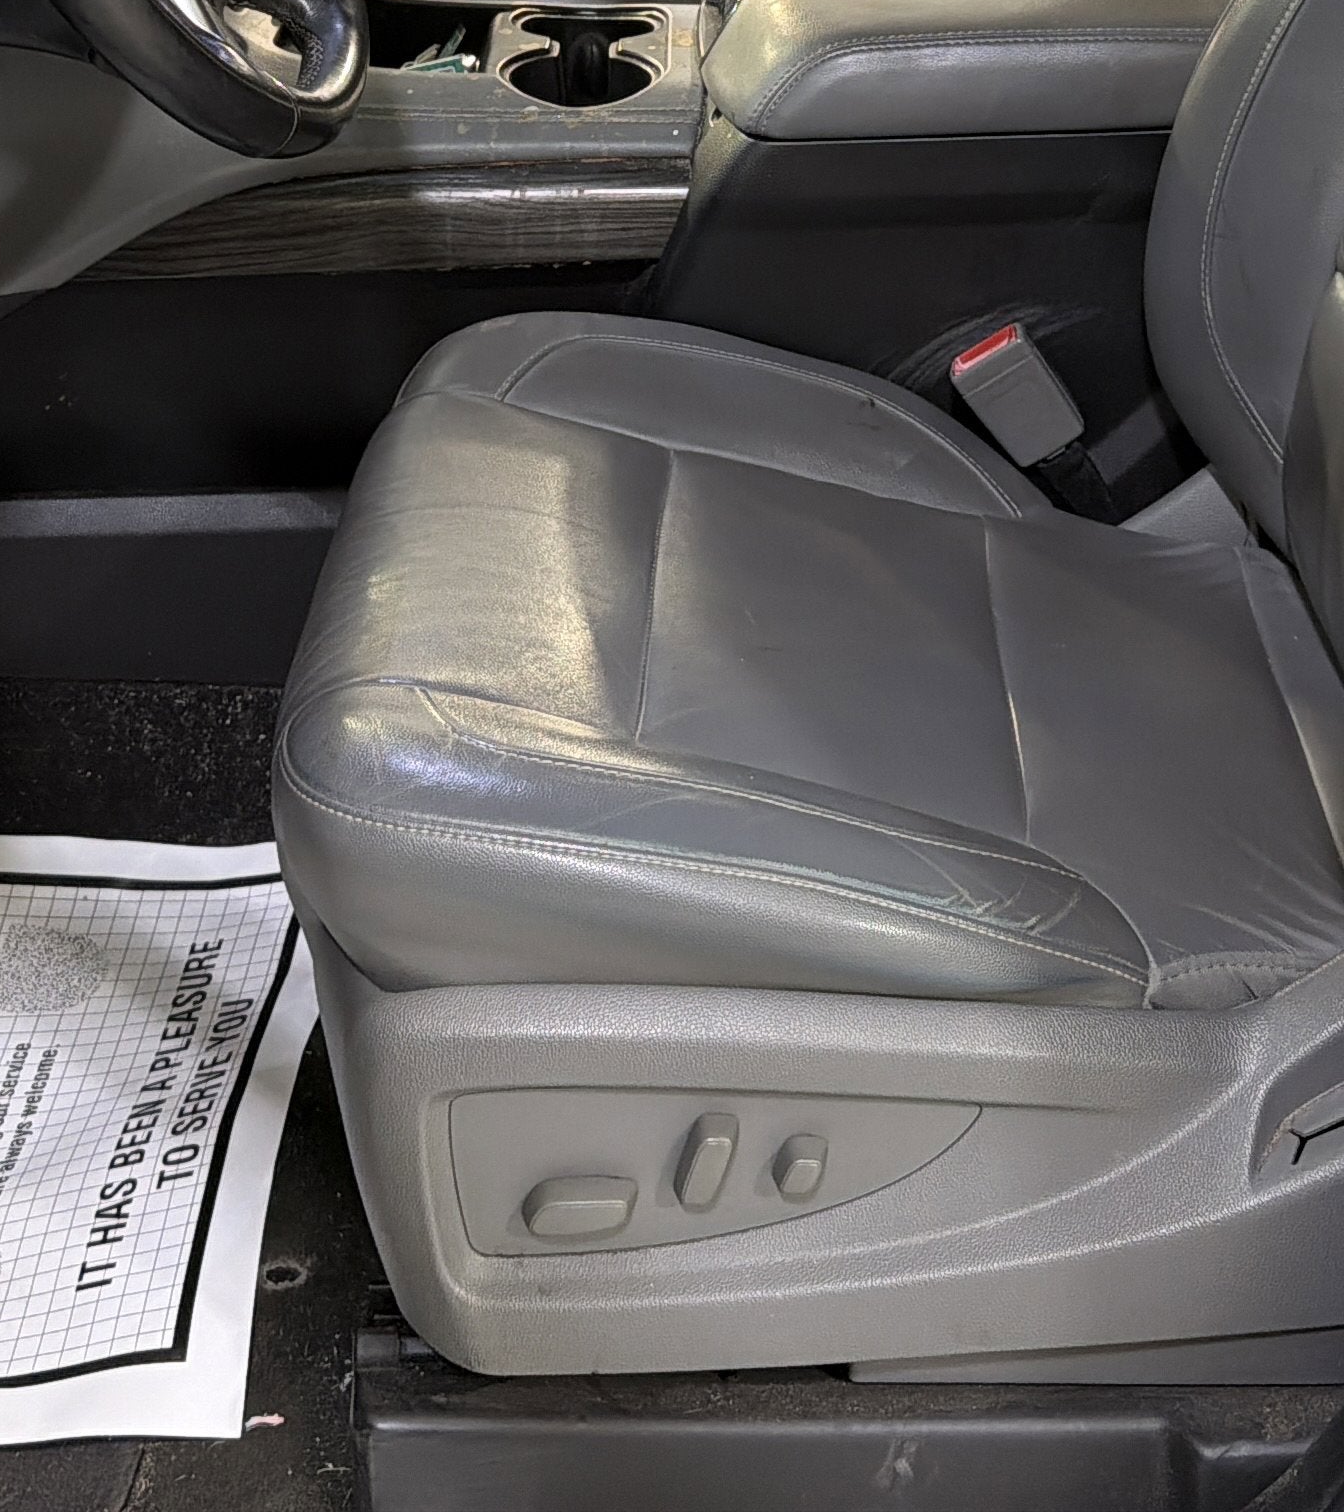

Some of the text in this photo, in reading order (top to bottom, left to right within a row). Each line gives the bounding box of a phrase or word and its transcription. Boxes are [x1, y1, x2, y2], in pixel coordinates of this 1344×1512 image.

[0, 1042, 31, 1098] service
[21, 1043, 61, 1117] welcome.
[76, 938, 224, 1292] IT HAS BEEN A PLEASURE
[156, 998, 254, 1189] TO SERVE YOU
